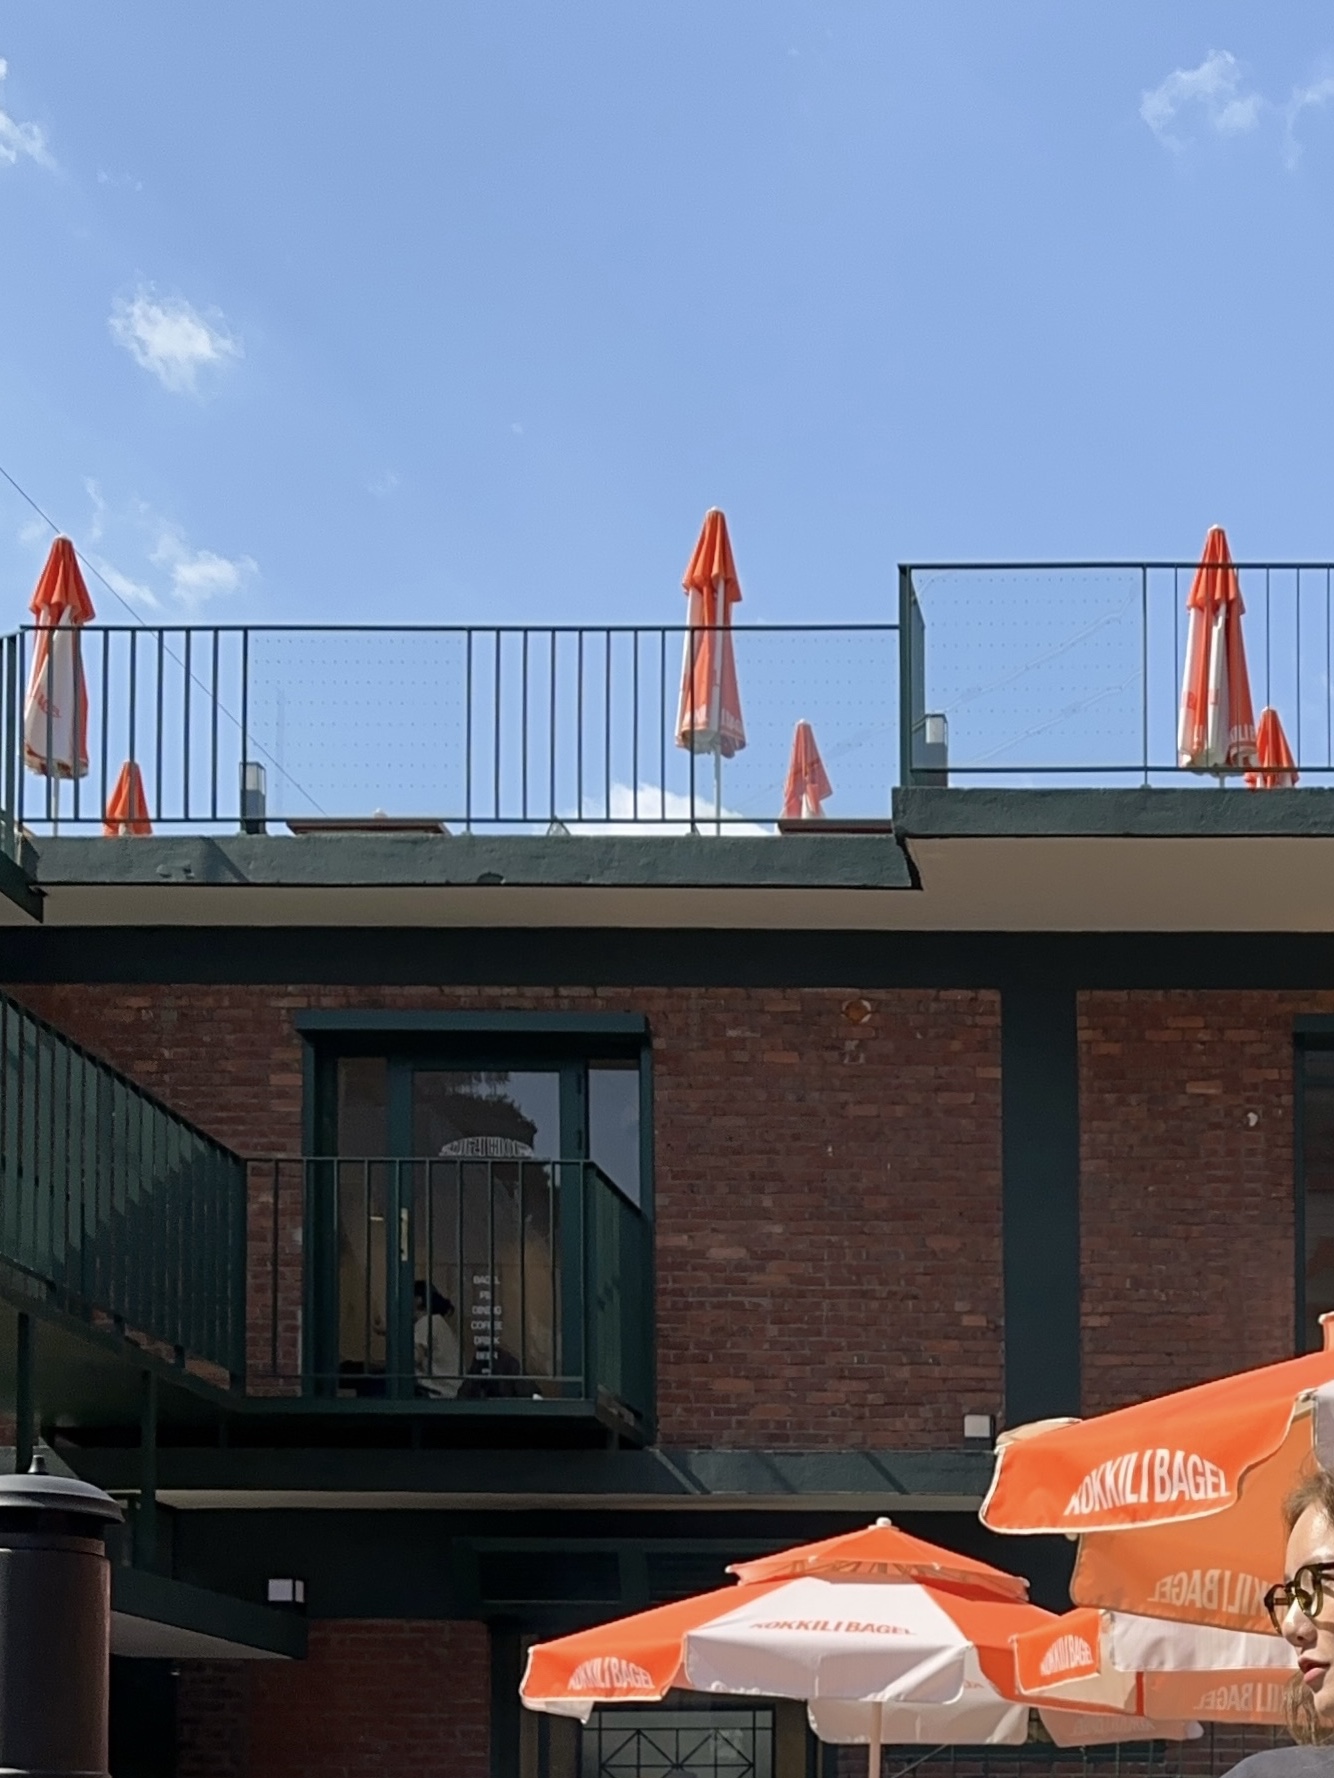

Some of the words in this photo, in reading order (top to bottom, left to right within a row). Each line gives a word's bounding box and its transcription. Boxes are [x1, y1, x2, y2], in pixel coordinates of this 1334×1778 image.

[1063, 1449, 1154, 1516] KOKKILI
[1154, 1448, 1231, 1503] BAGEL
[844, 1621, 917, 1635] BAGEL
